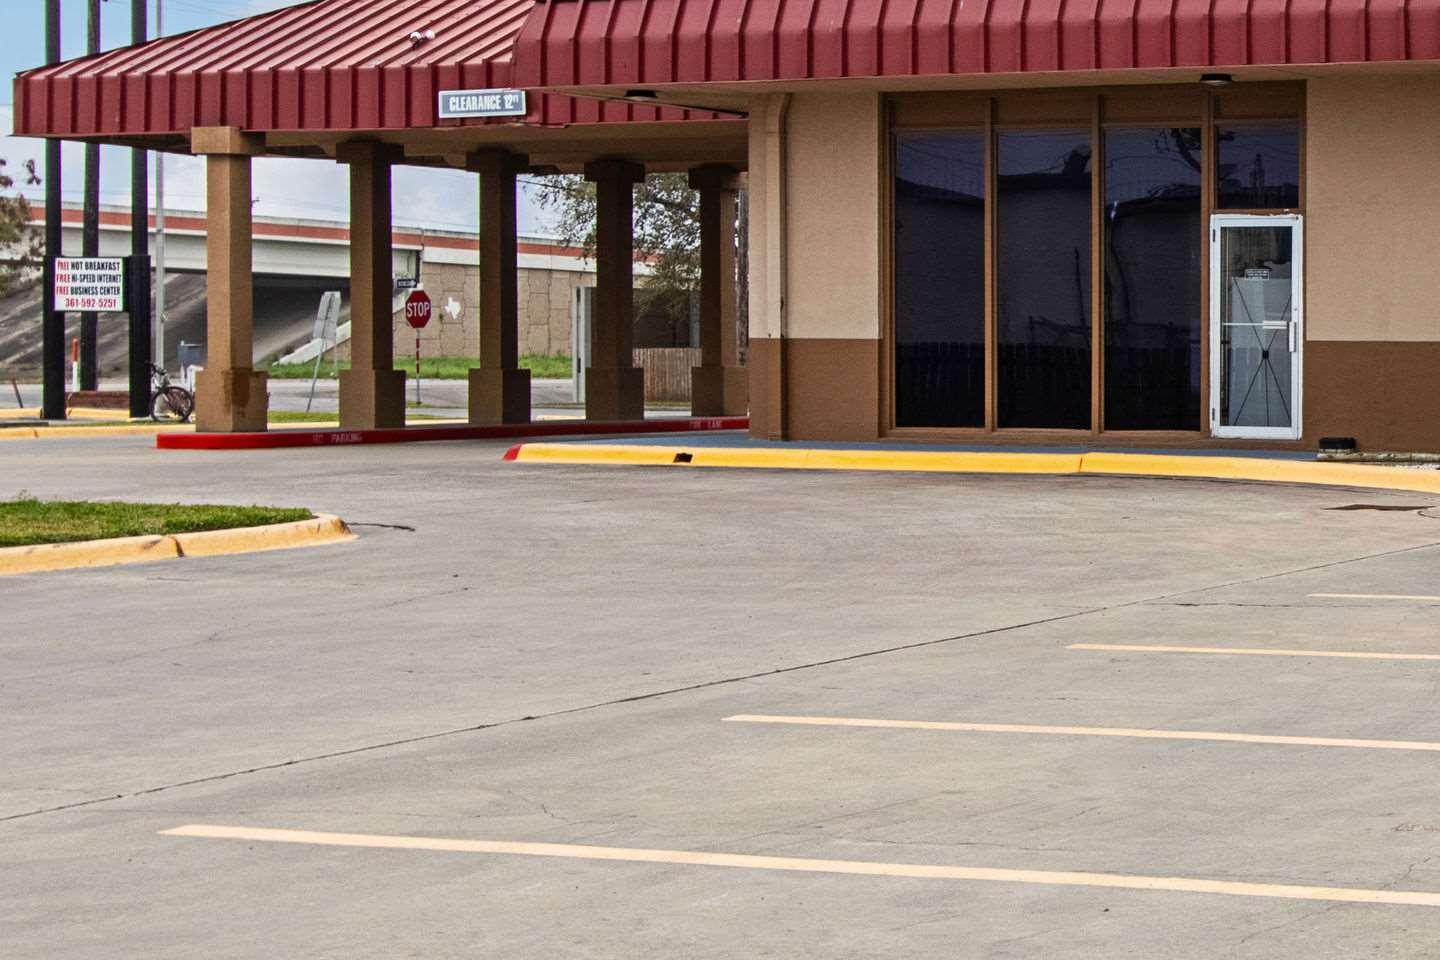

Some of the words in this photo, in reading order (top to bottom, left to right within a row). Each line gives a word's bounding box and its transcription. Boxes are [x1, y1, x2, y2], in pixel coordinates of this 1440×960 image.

[449, 95, 502, 112] CLEARANCE
[57, 261, 69, 271] FREE
[70, 261, 83, 271] HOT
[84, 261, 121, 271] BREAKFAST
[56, 273, 70, 283] FREE
[97, 273, 122, 283] INTERNET
[56, 286, 69, 296] FREE
[70, 286, 98, 296] BUSINESS
[99, 286, 121, 296] CENTER
[406, 301, 430, 318] STOP
